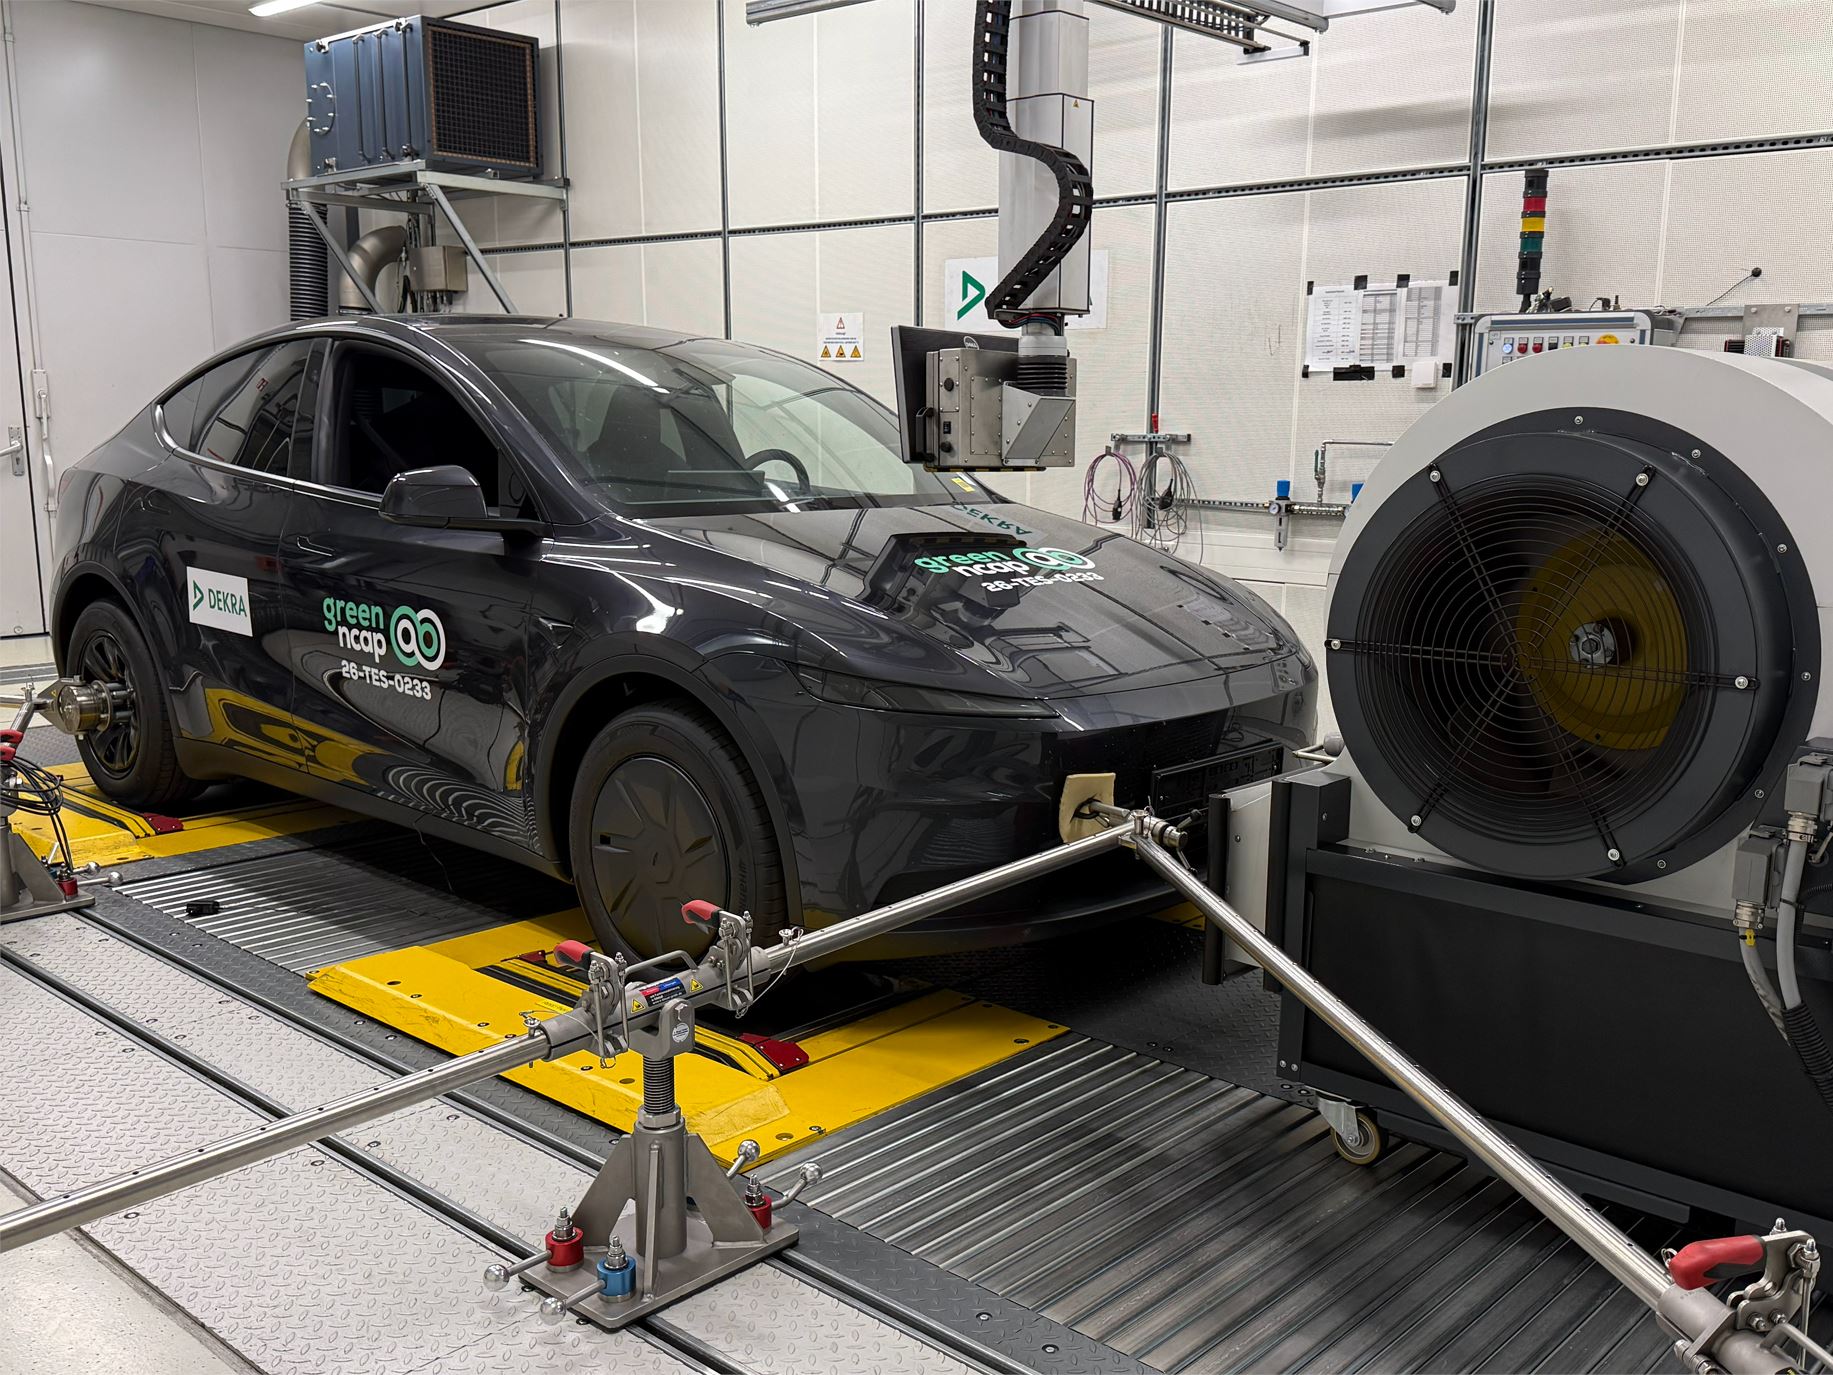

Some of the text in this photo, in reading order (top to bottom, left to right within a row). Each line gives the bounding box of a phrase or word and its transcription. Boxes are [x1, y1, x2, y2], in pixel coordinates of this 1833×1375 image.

[914, 550, 1011, 574] green
[953, 560, 1030, 577] ncap
[981, 572, 1104, 591] 26-TES-0233
[208, 589, 247, 617] DEKRA
[322, 596, 384, 632] green
[338, 625, 387, 663] ncap
[341, 660, 431, 700] 26-TES-0233
